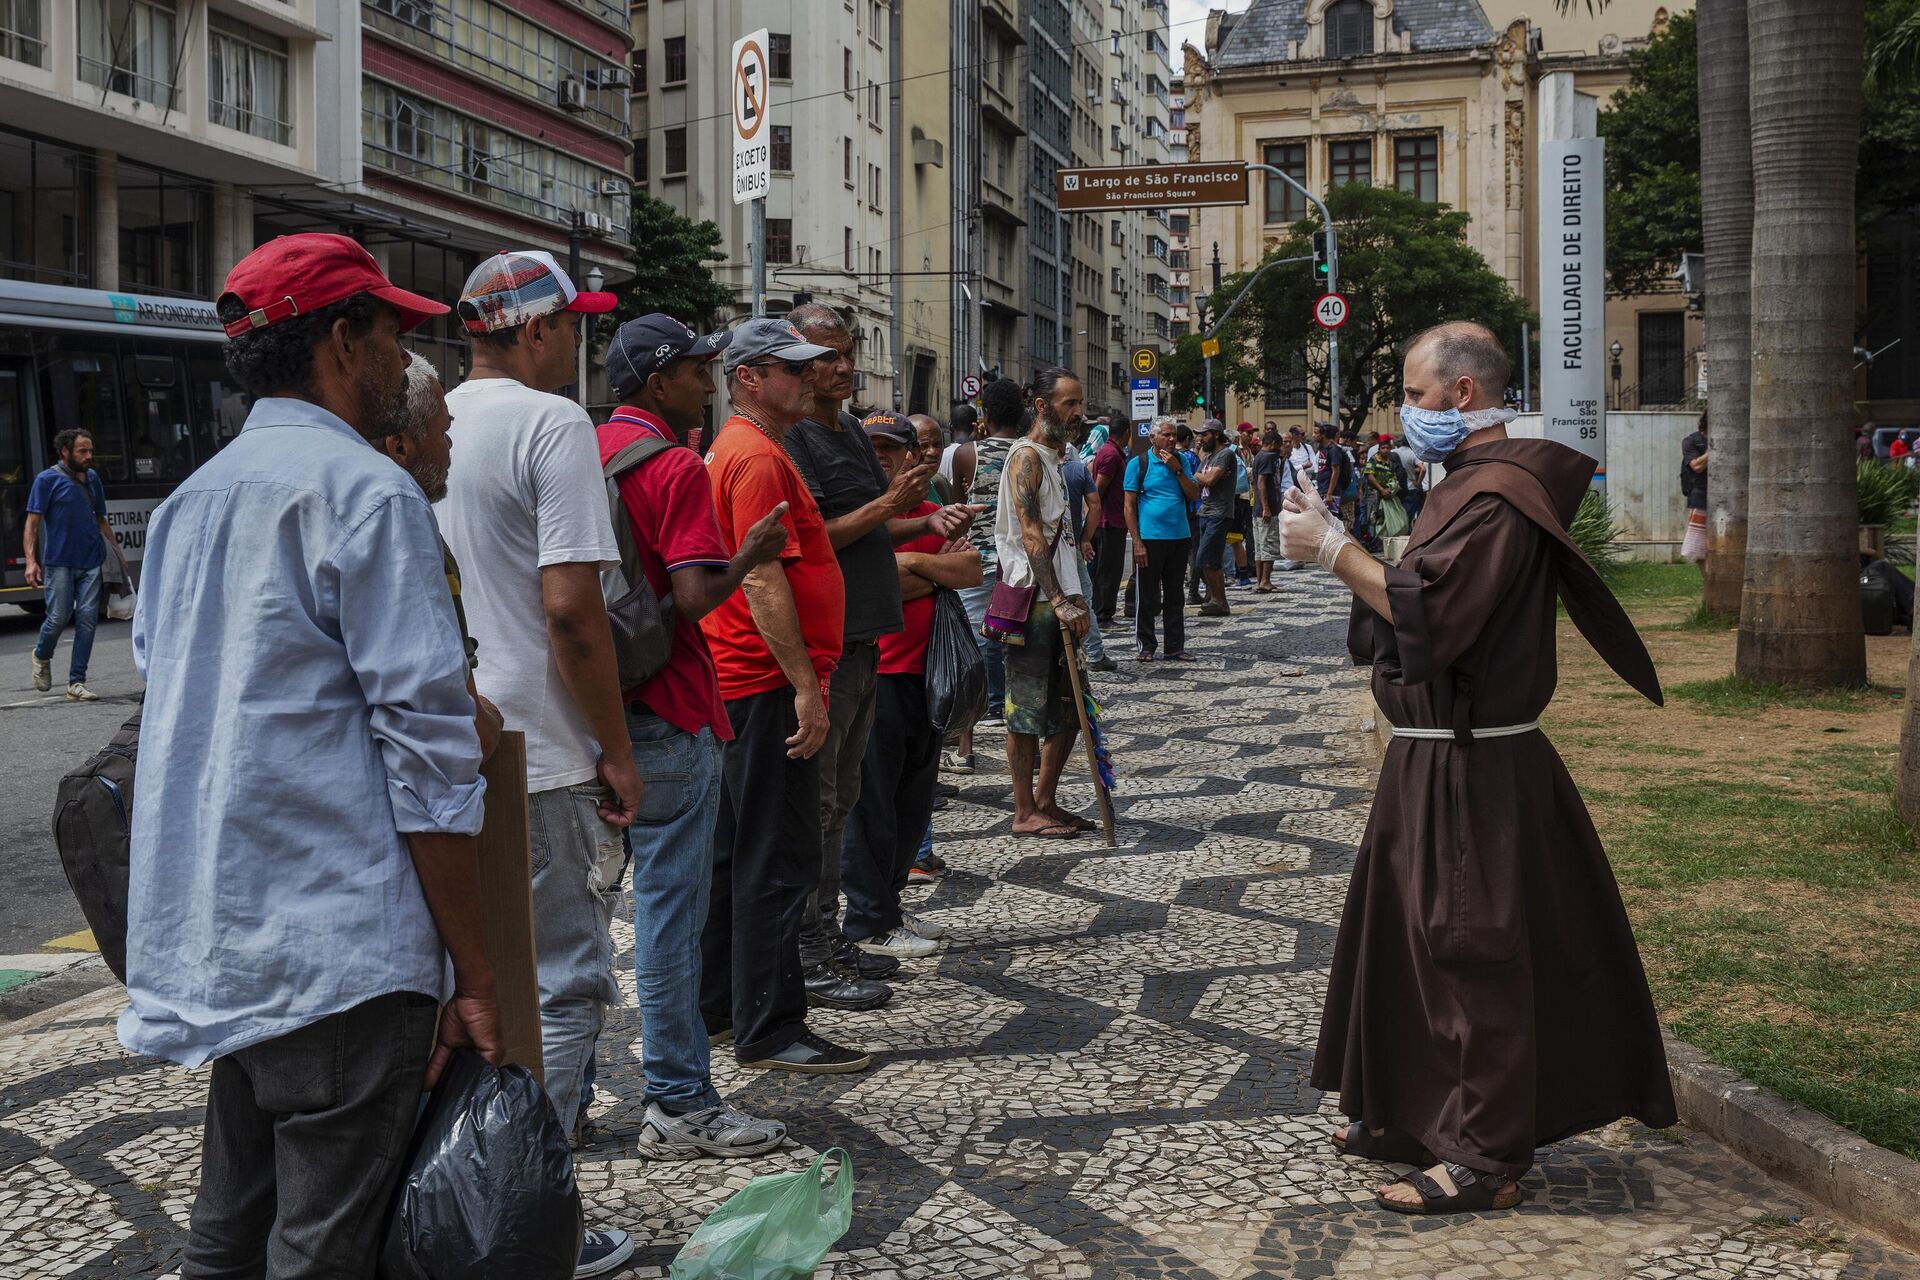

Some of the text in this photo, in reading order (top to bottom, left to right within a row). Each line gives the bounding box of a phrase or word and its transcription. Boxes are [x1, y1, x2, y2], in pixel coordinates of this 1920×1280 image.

[744, 63, 756, 120] E
[736, 145, 767, 170] EXCETO
[736, 171, 766, 194] ÔNIBUS
[1084, 171, 1239, 189] Largo de São Francisco
[1105, 190, 1197, 200] São Francisco Square
[1563, 154, 1582, 369] FACULDADE DE DIREITO
[154, 303, 220, 326] CONDICION
[1320, 301, 1342, 316] 40
[1570, 398, 1598, 409] Largo
[1552, 417, 1598, 426] Francisco
[1580, 426, 1597, 439] 95
